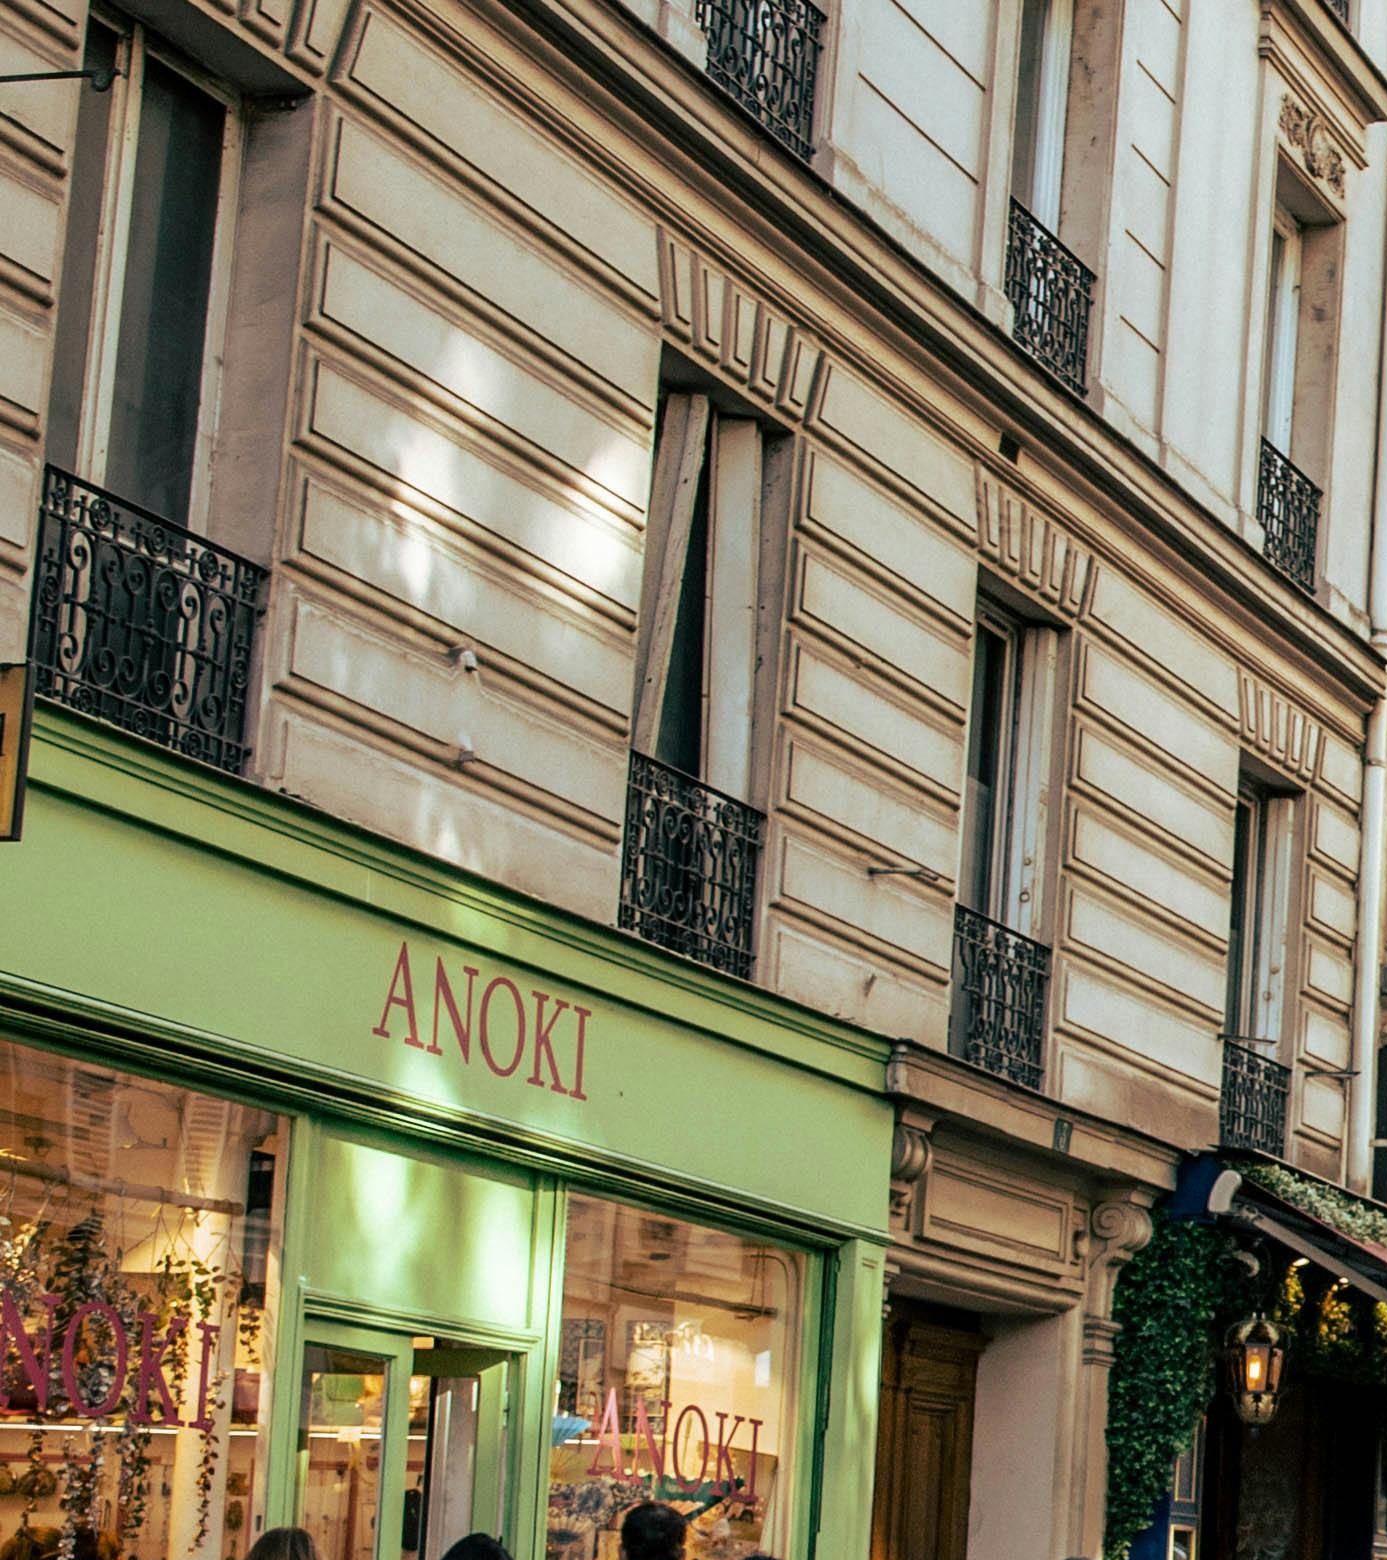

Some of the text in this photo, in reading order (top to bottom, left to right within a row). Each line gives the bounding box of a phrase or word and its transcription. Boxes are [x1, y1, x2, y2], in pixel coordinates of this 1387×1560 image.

[372, 940, 593, 1101] ANOKI
[0, 1287, 221, 1433] NOKI
[586, 1386, 764, 1504] ANOKI
